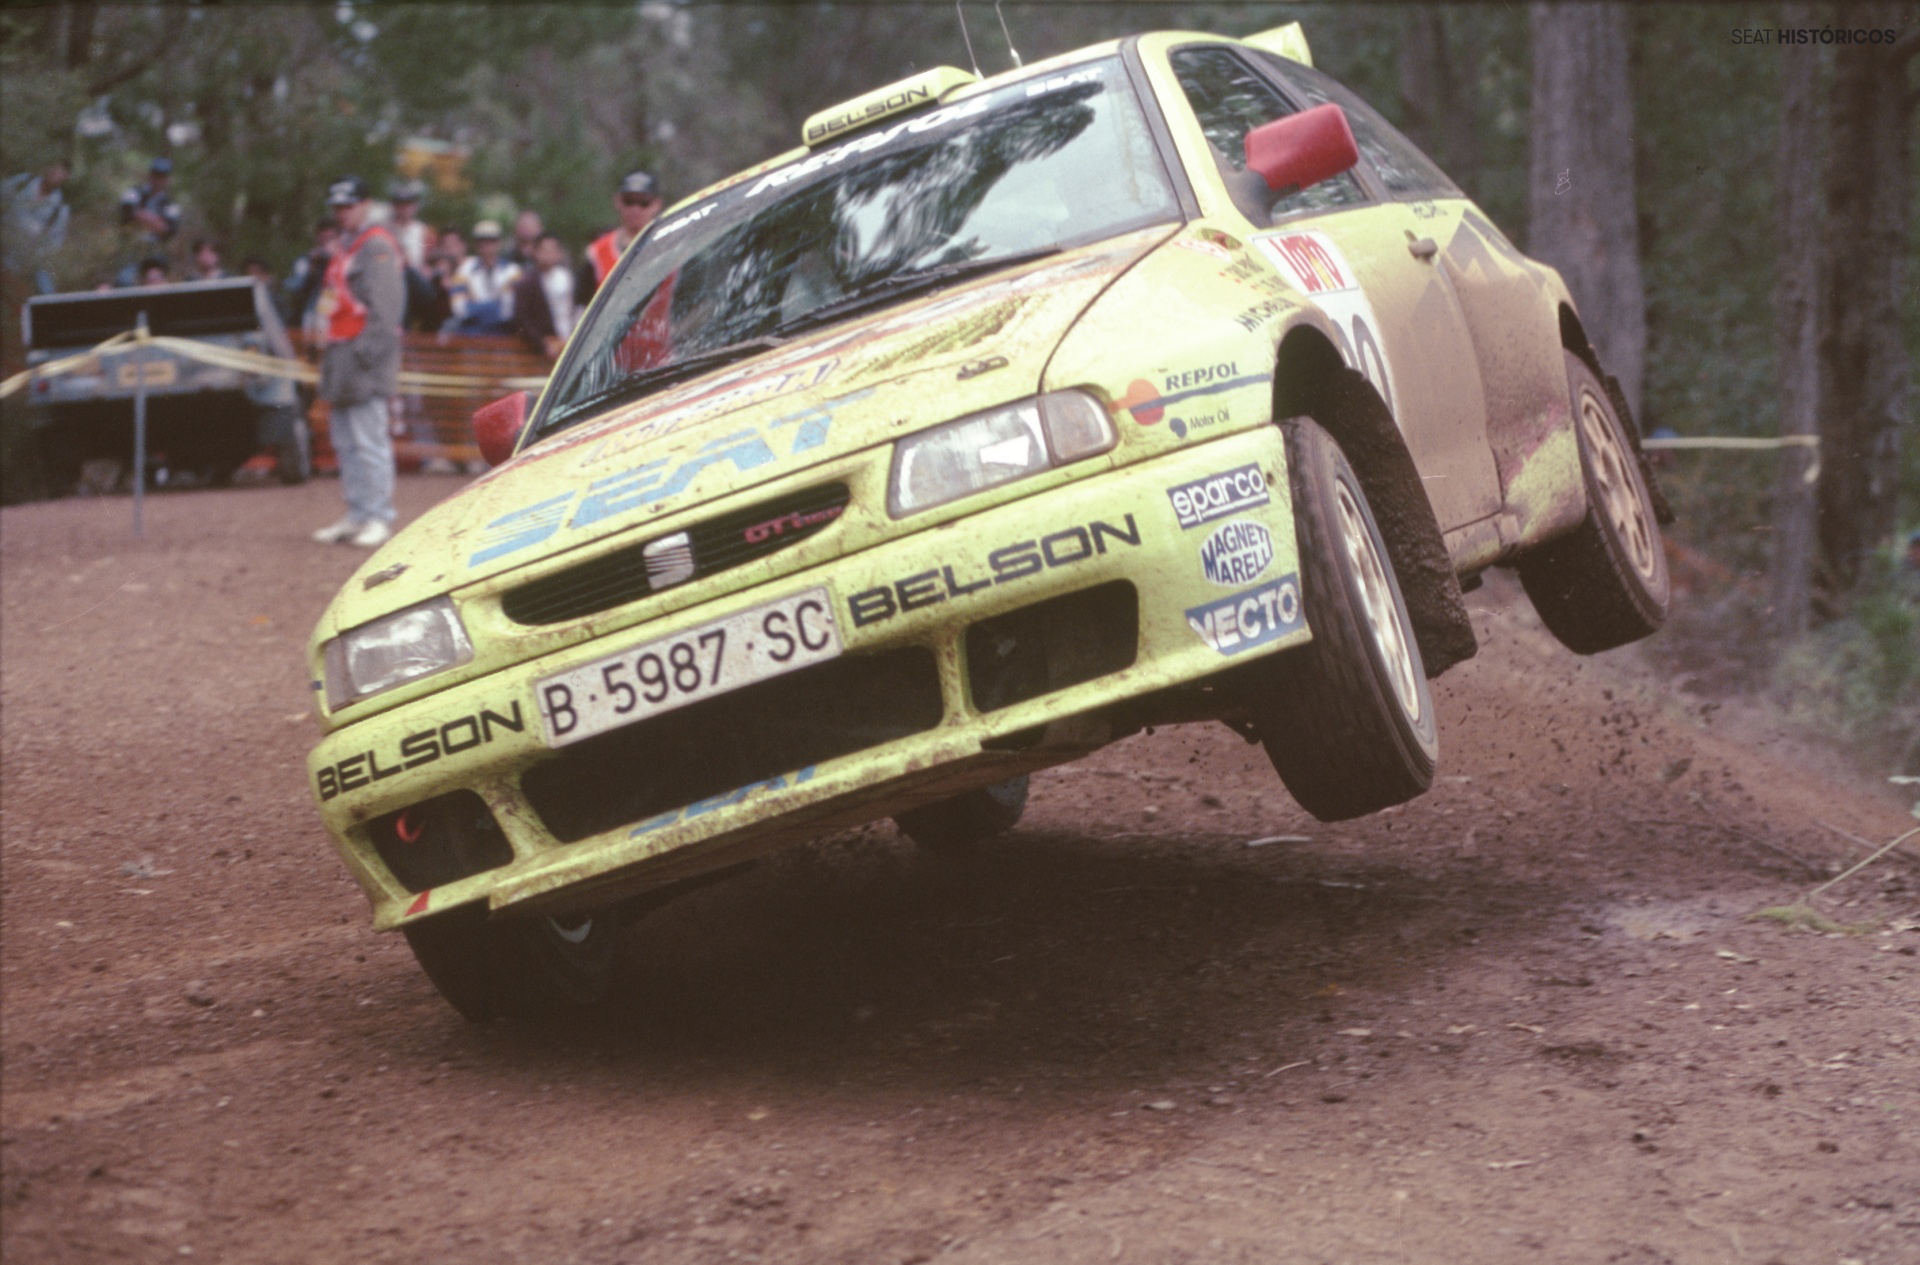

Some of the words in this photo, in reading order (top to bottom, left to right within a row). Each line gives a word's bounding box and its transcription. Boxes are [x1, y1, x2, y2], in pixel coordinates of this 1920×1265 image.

[806, 85, 929, 142] BELSON
[1165, 361, 1240, 392] REPSOL
[1189, 415, 1216, 431] Motor
[1217, 407, 1230, 423] Oil
[467, 386, 877, 568] SEAT
[1172, 468, 1266, 523] sparco
[847, 512, 1142, 628] BELSON
[1201, 522, 1274, 578] MAGNETI
[1201, 541, 1274, 585] MARELLI
[316, 699, 525, 802] BELSON
